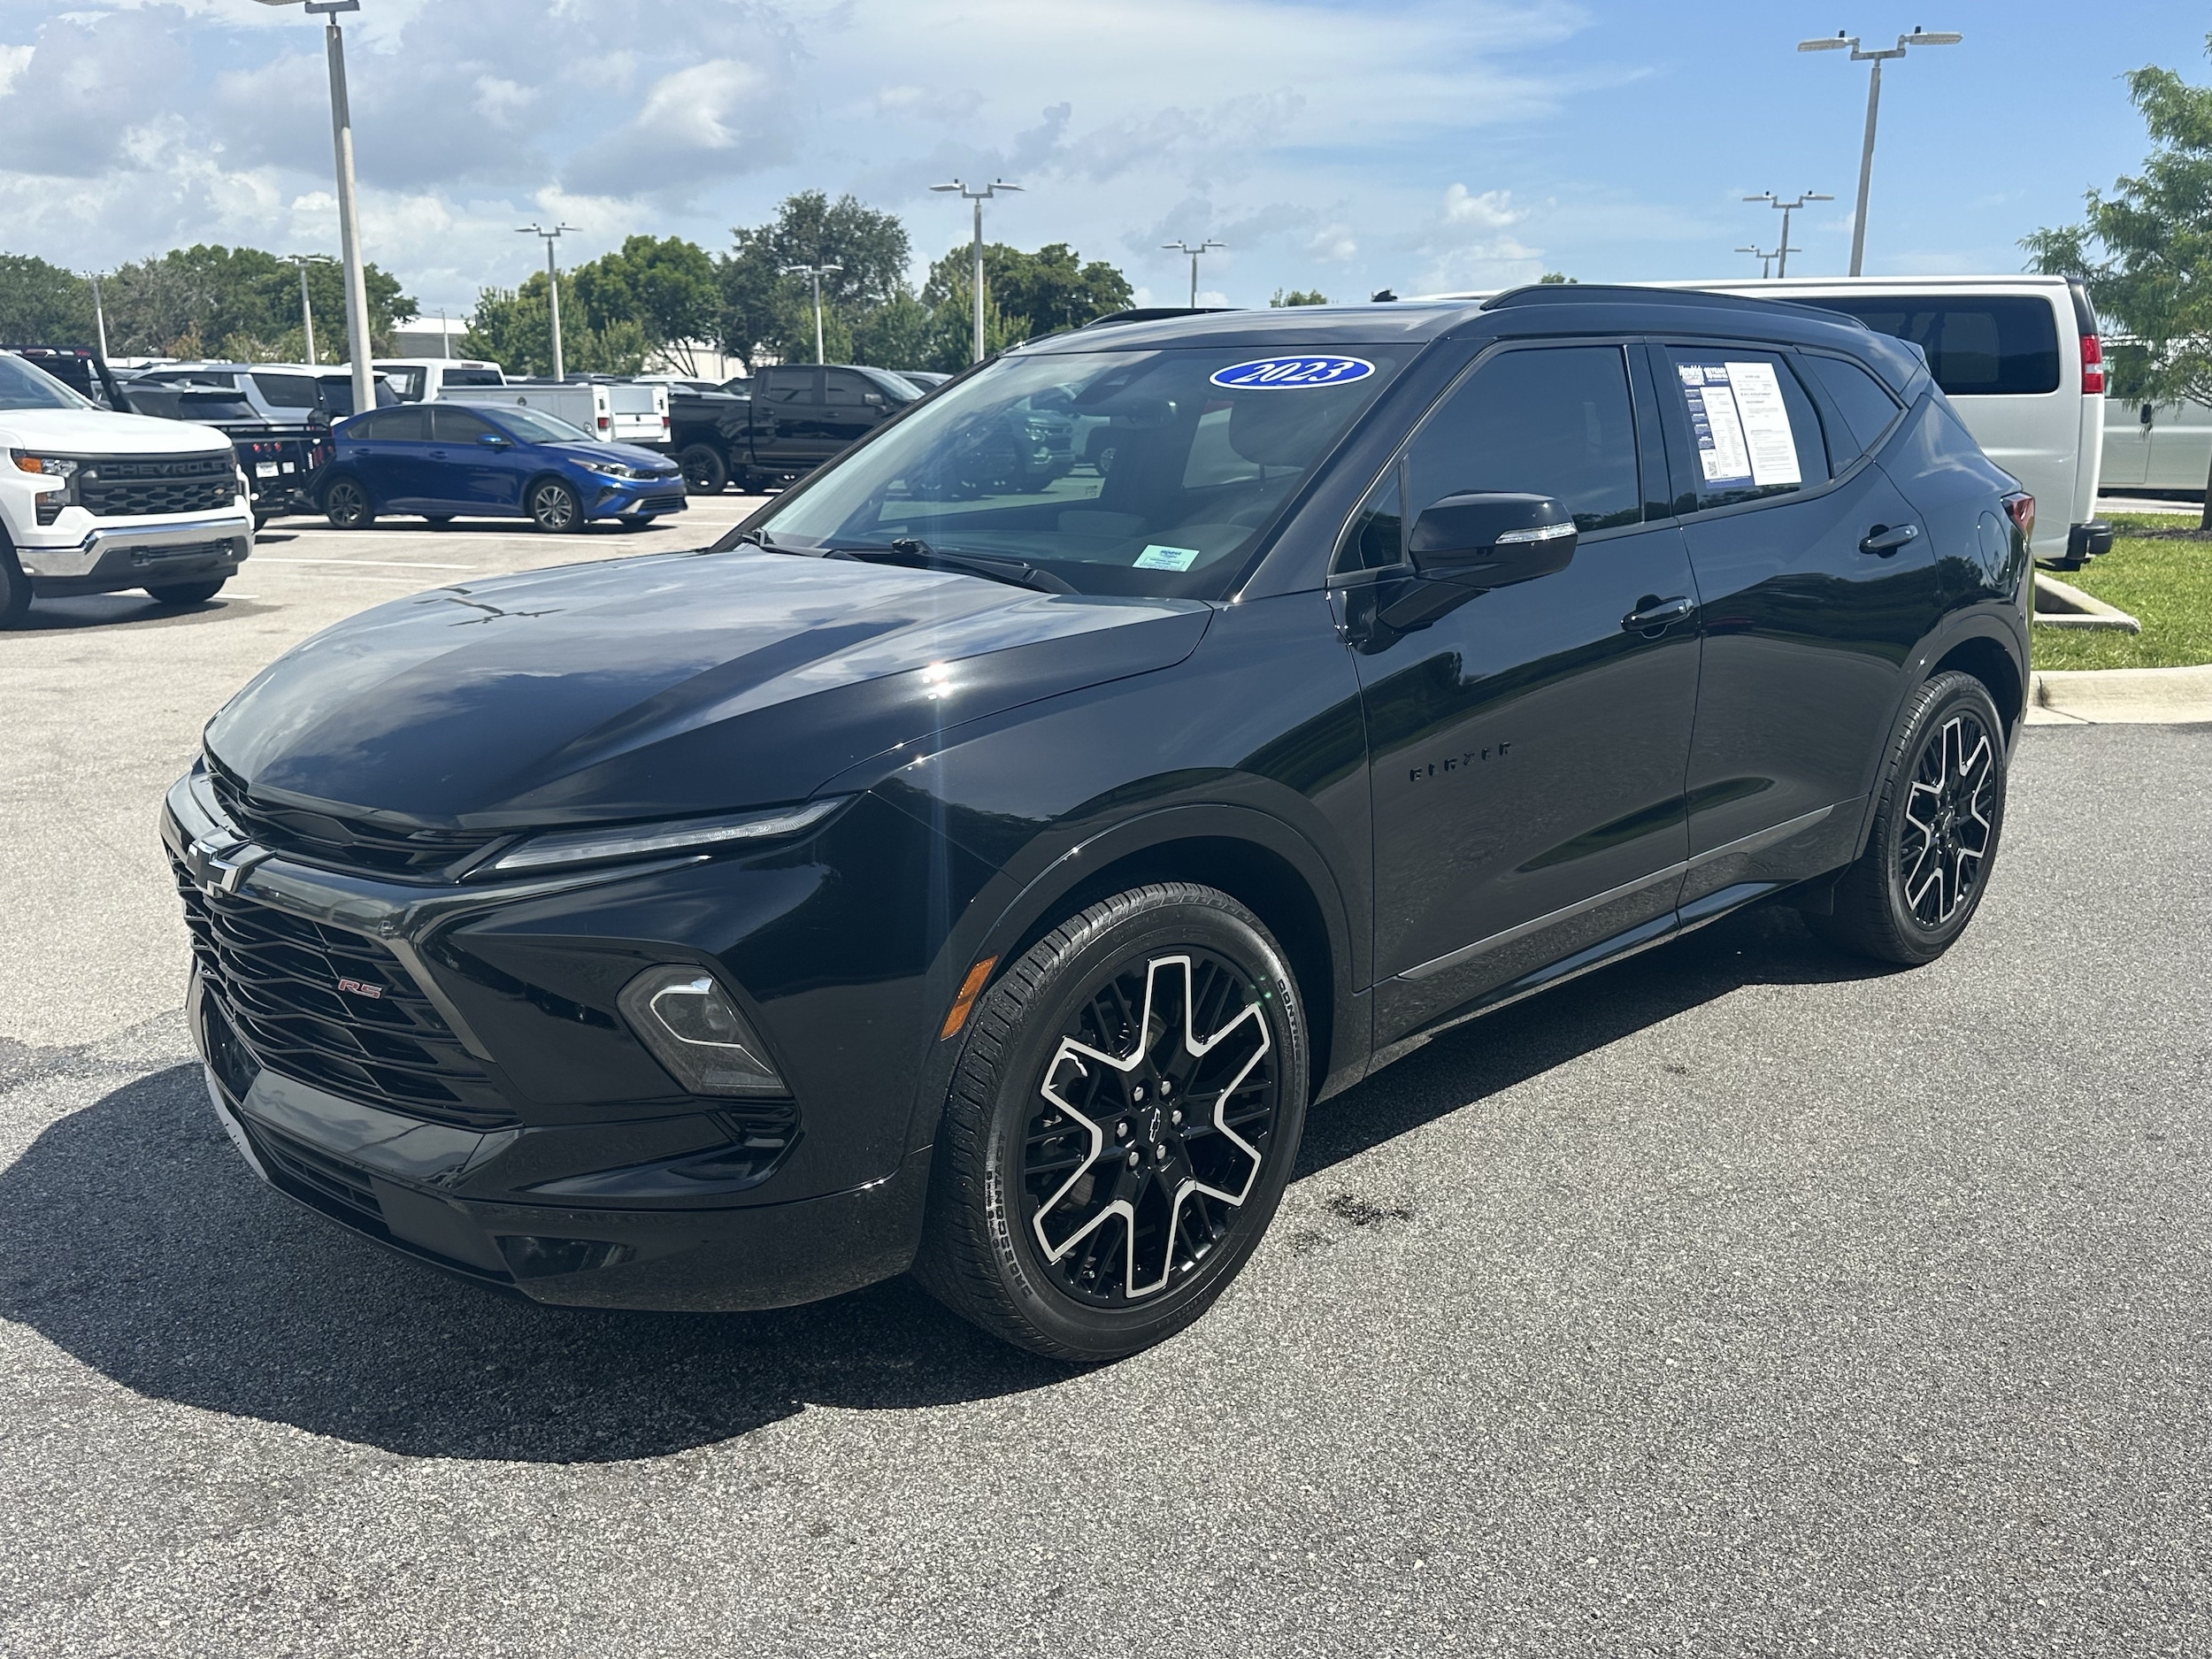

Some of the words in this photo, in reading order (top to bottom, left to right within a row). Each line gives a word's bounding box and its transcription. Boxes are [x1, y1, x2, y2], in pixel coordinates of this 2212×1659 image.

[1230, 361, 1355, 383] 2023
[1409, 741, 1511, 781] BLAZER
[338, 979, 382, 999] RS
[994, 1130, 1033, 1299] CROSSCONTACT
